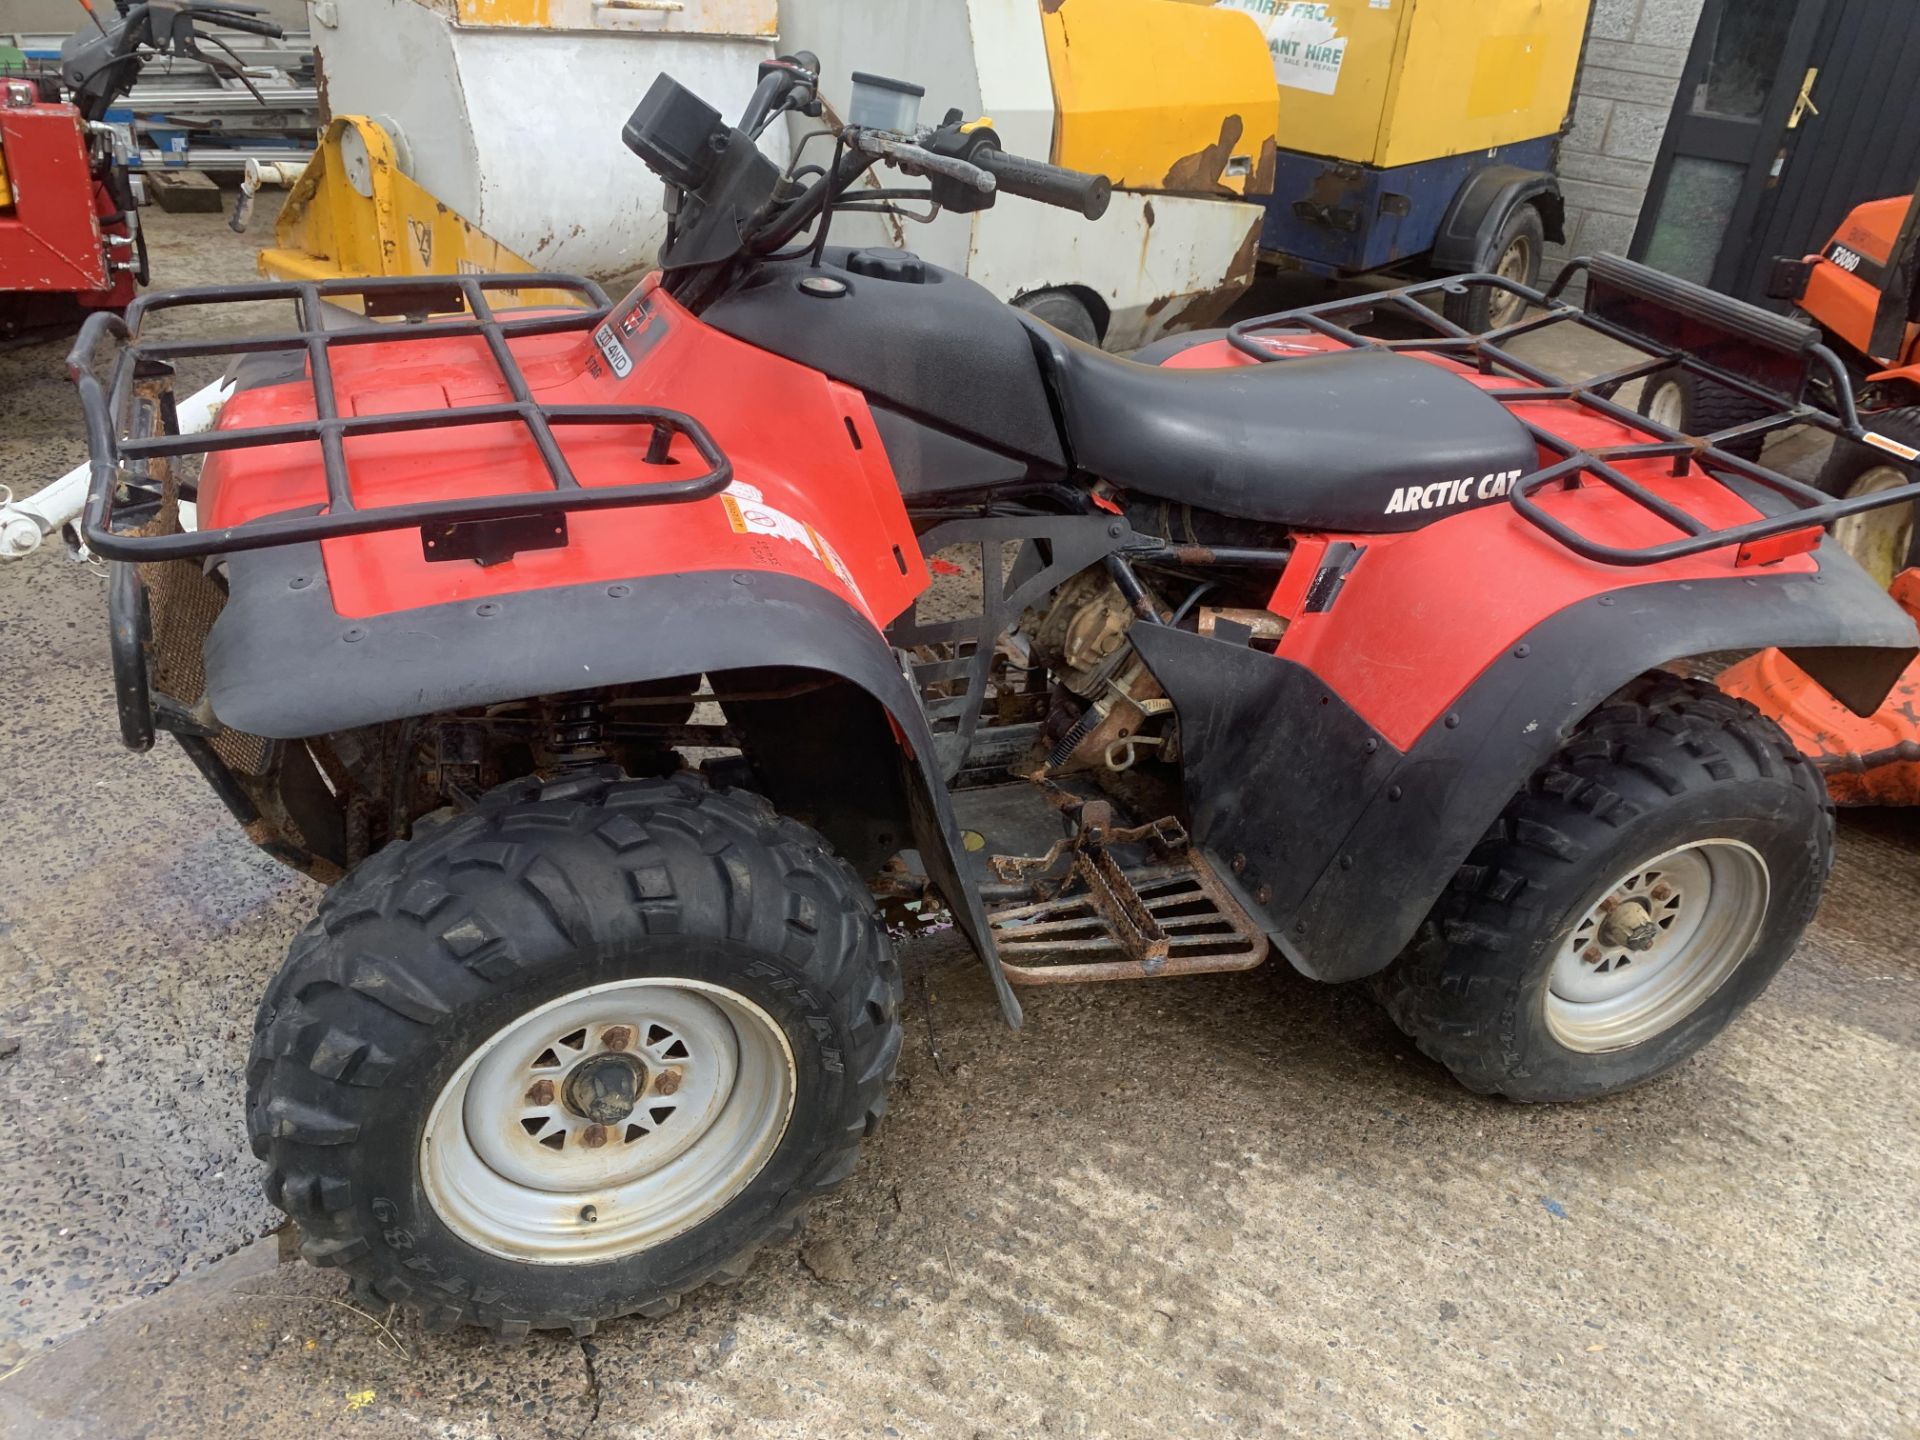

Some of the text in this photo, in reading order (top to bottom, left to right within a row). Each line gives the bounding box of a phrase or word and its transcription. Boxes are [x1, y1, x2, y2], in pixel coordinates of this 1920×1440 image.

[1269, 37, 1343, 64] ANT HIRE
[607, 344, 627, 371] 4WD
[1383, 469, 1522, 514] ARCTIC CAT
[743, 960, 845, 1074] TITAN
